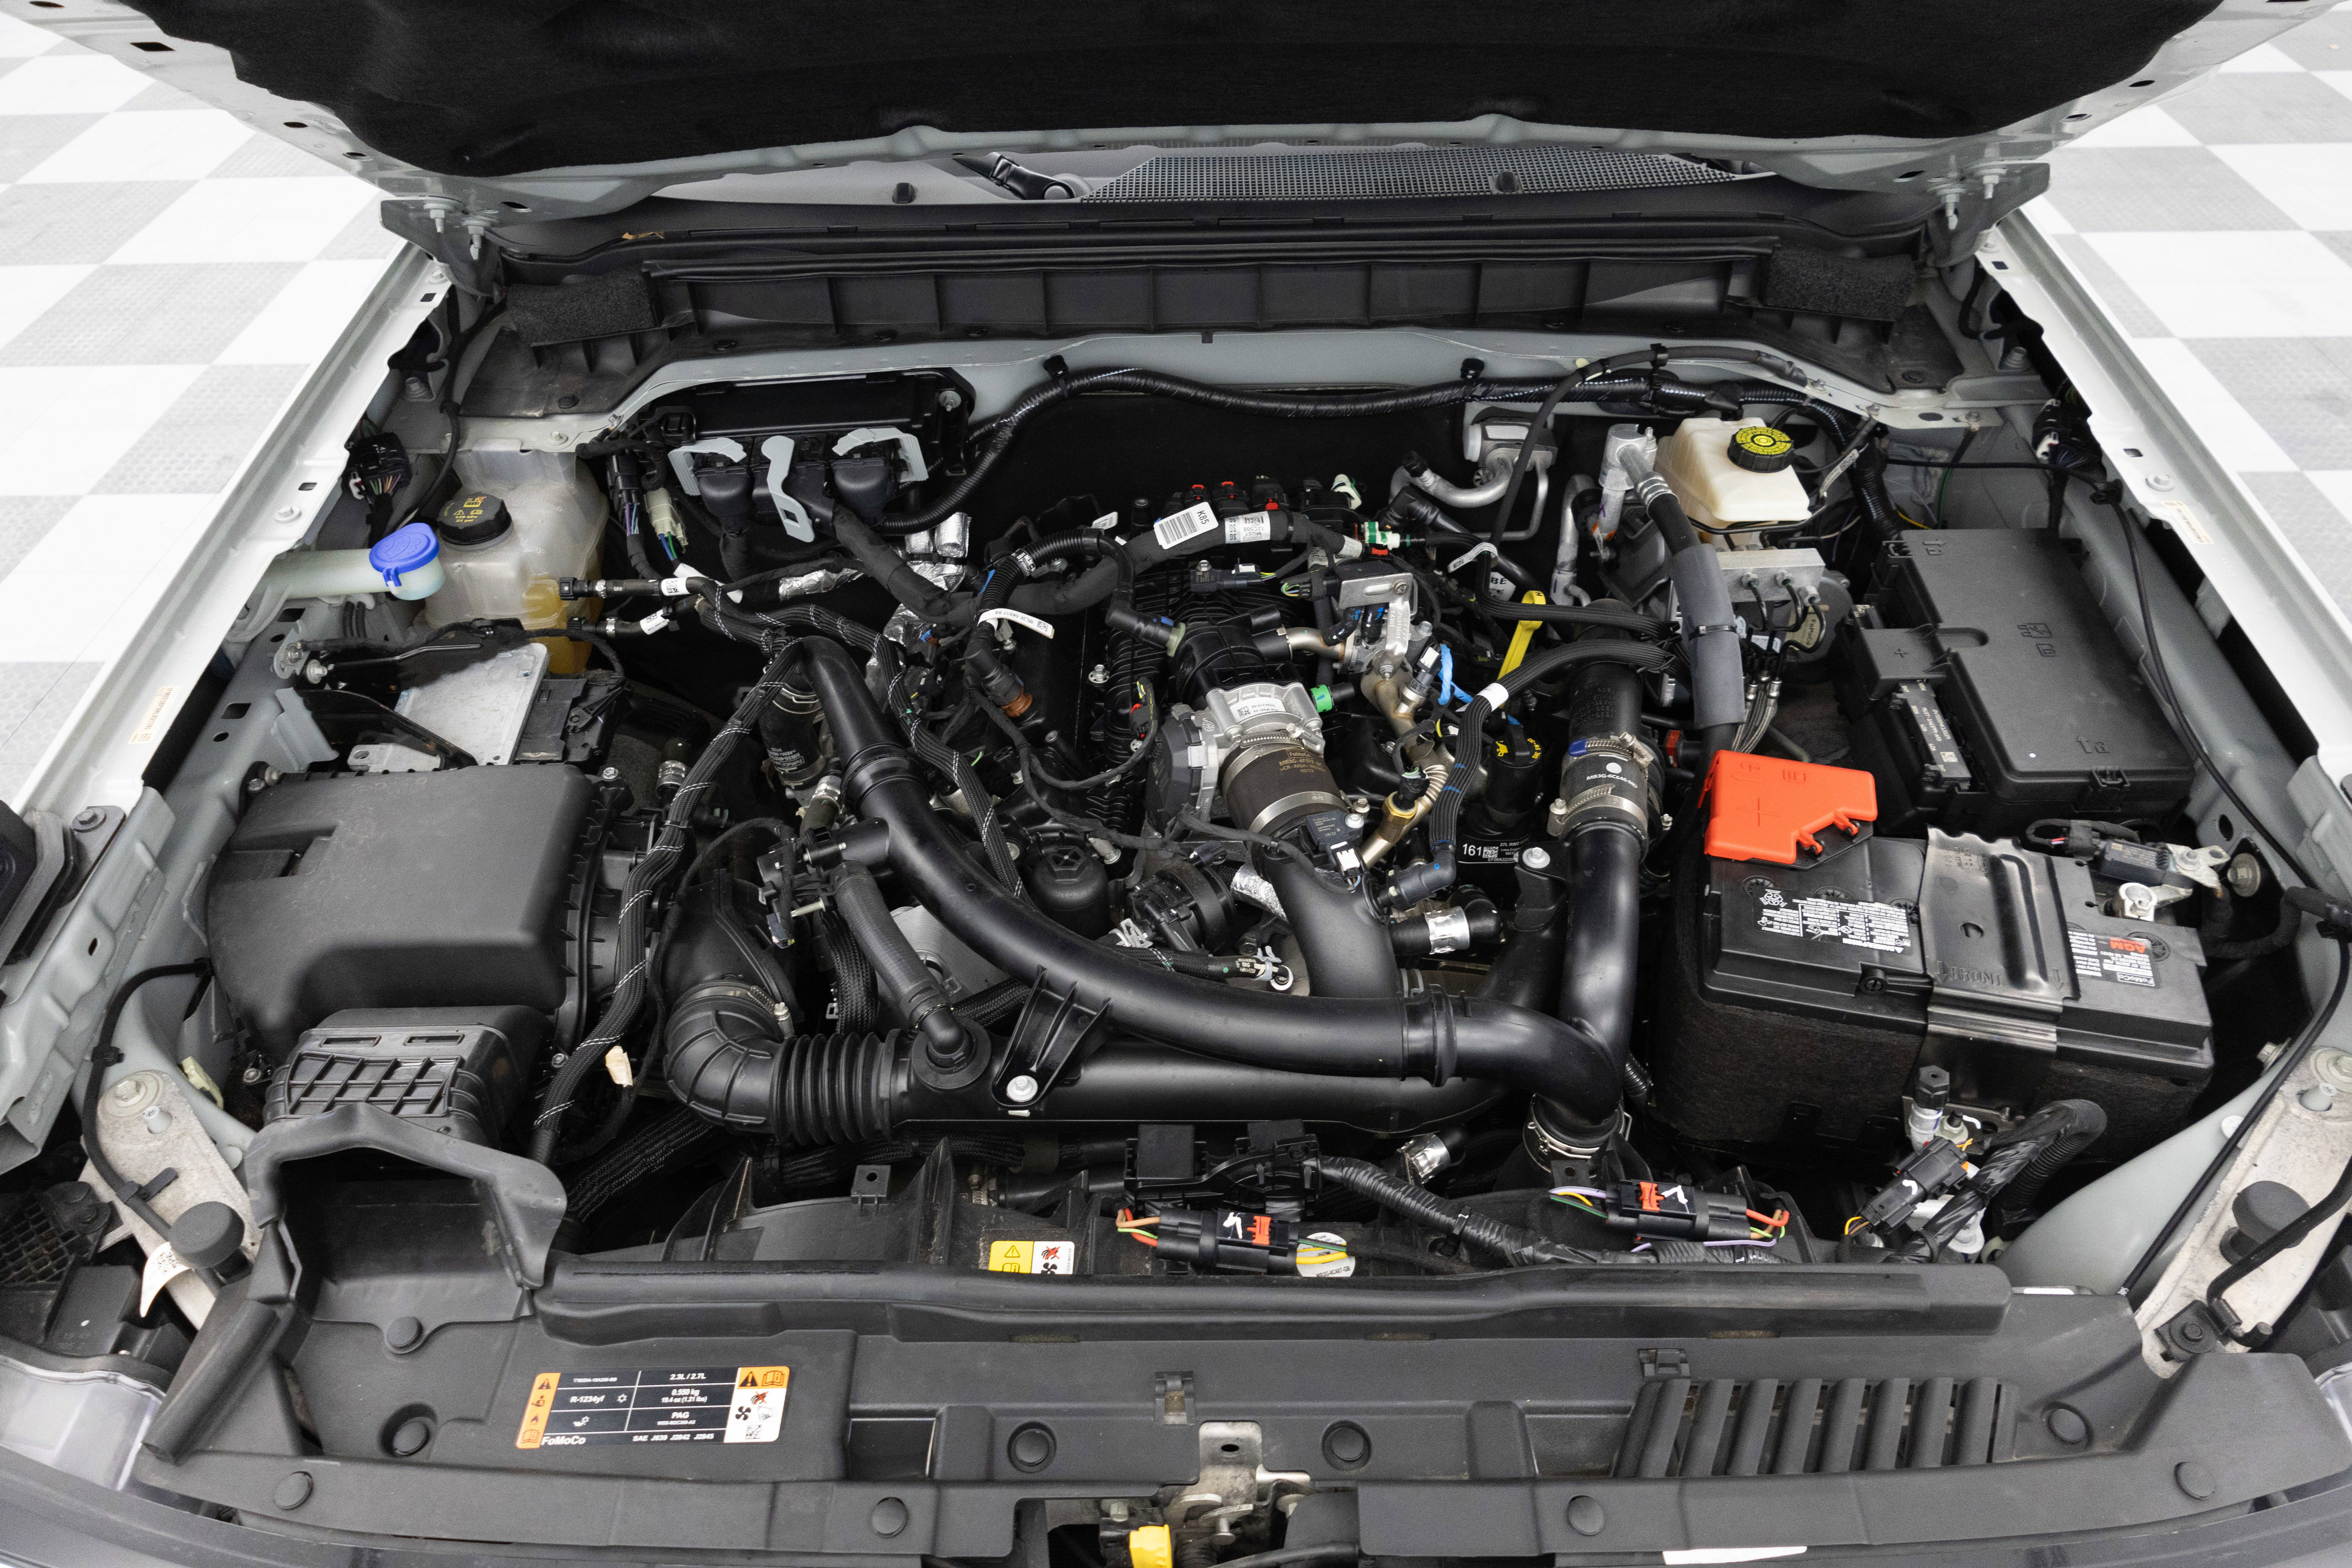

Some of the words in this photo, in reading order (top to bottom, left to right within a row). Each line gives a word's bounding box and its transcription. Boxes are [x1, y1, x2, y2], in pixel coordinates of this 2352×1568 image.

[1196, 510, 1209, 525] K85
[1808, 619, 1817, 645] FoMoCo
[1462, 843, 1481, 856] 161
[2109, 941, 2146, 953] AGM
[2118, 974, 2152, 984] FoMoCo
[690, 1388, 700, 1396] kg
[570, 1394, 605, 1404] R-1234yf
[671, 1411, 690, 1419] PAG
[541, 1435, 586, 1446] FoMoCo
